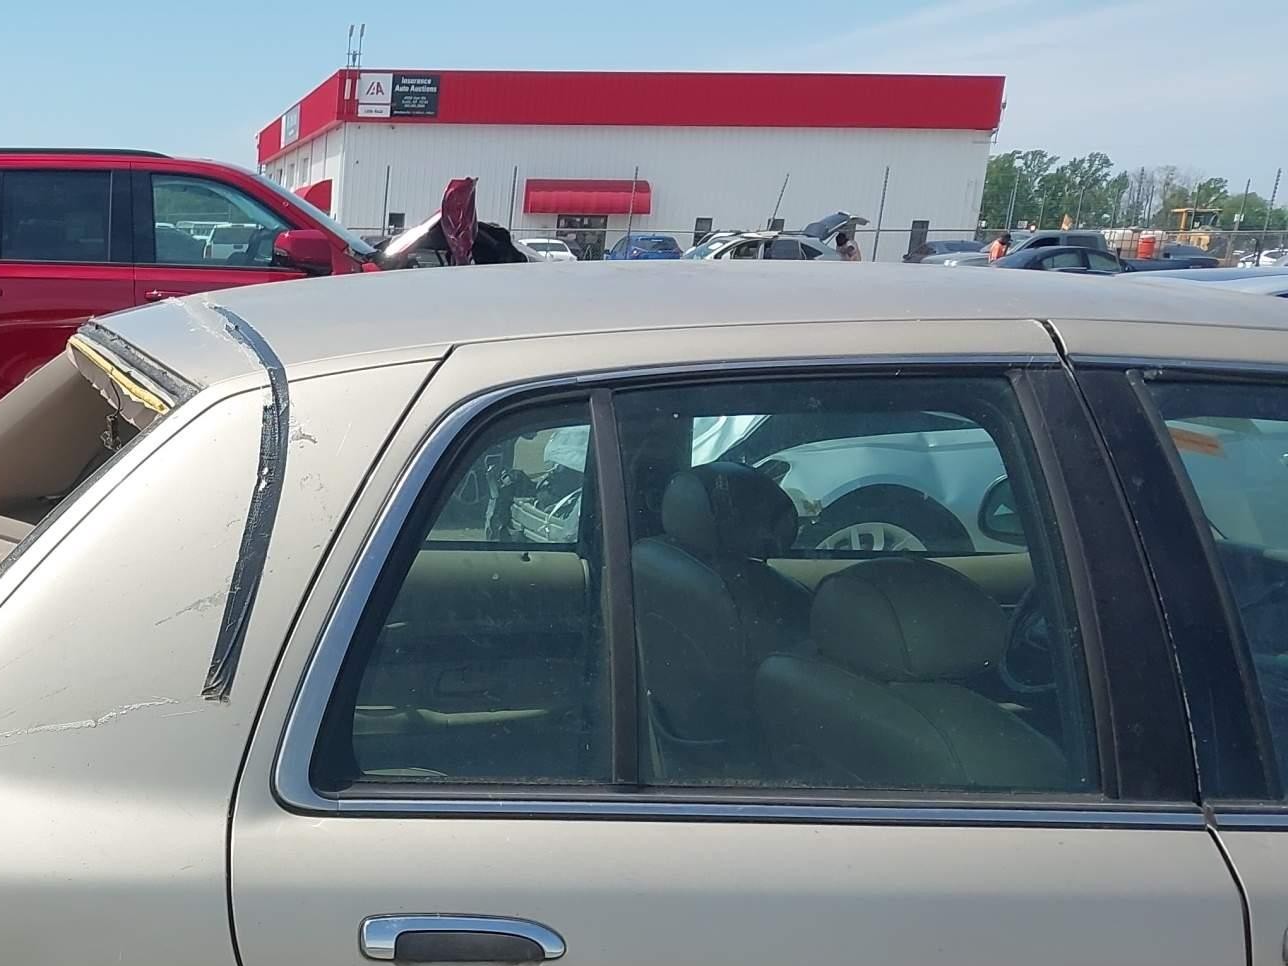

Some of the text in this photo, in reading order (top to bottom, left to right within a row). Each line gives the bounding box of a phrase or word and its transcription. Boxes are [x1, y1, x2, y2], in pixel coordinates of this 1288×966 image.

[401, 76, 431, 84] Insurance
[394, 84, 437, 92] Auto Auctions
